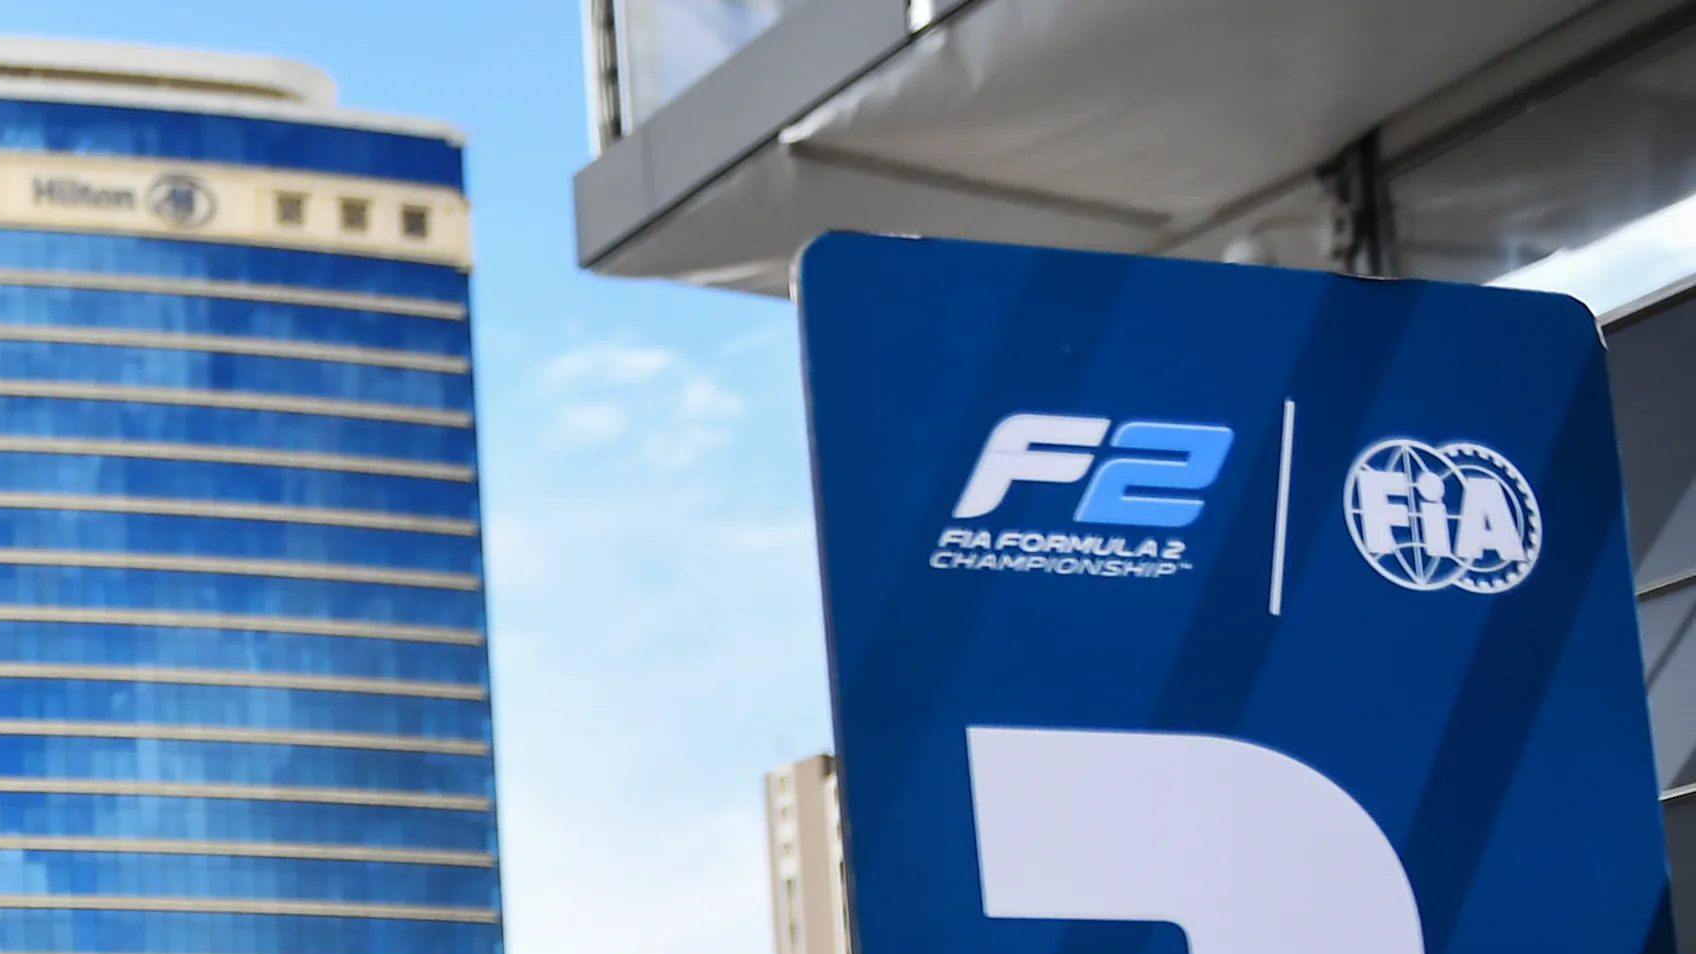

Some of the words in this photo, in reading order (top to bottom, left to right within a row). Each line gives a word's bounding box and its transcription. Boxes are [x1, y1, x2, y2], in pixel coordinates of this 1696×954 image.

[32, 176, 136, 209] Hilton
[951, 412, 1235, 528] F2
[937, 528, 991, 551] FIA
[994, 531, 1157, 558] FORMULA
[1161, 539, 1186, 561] 2
